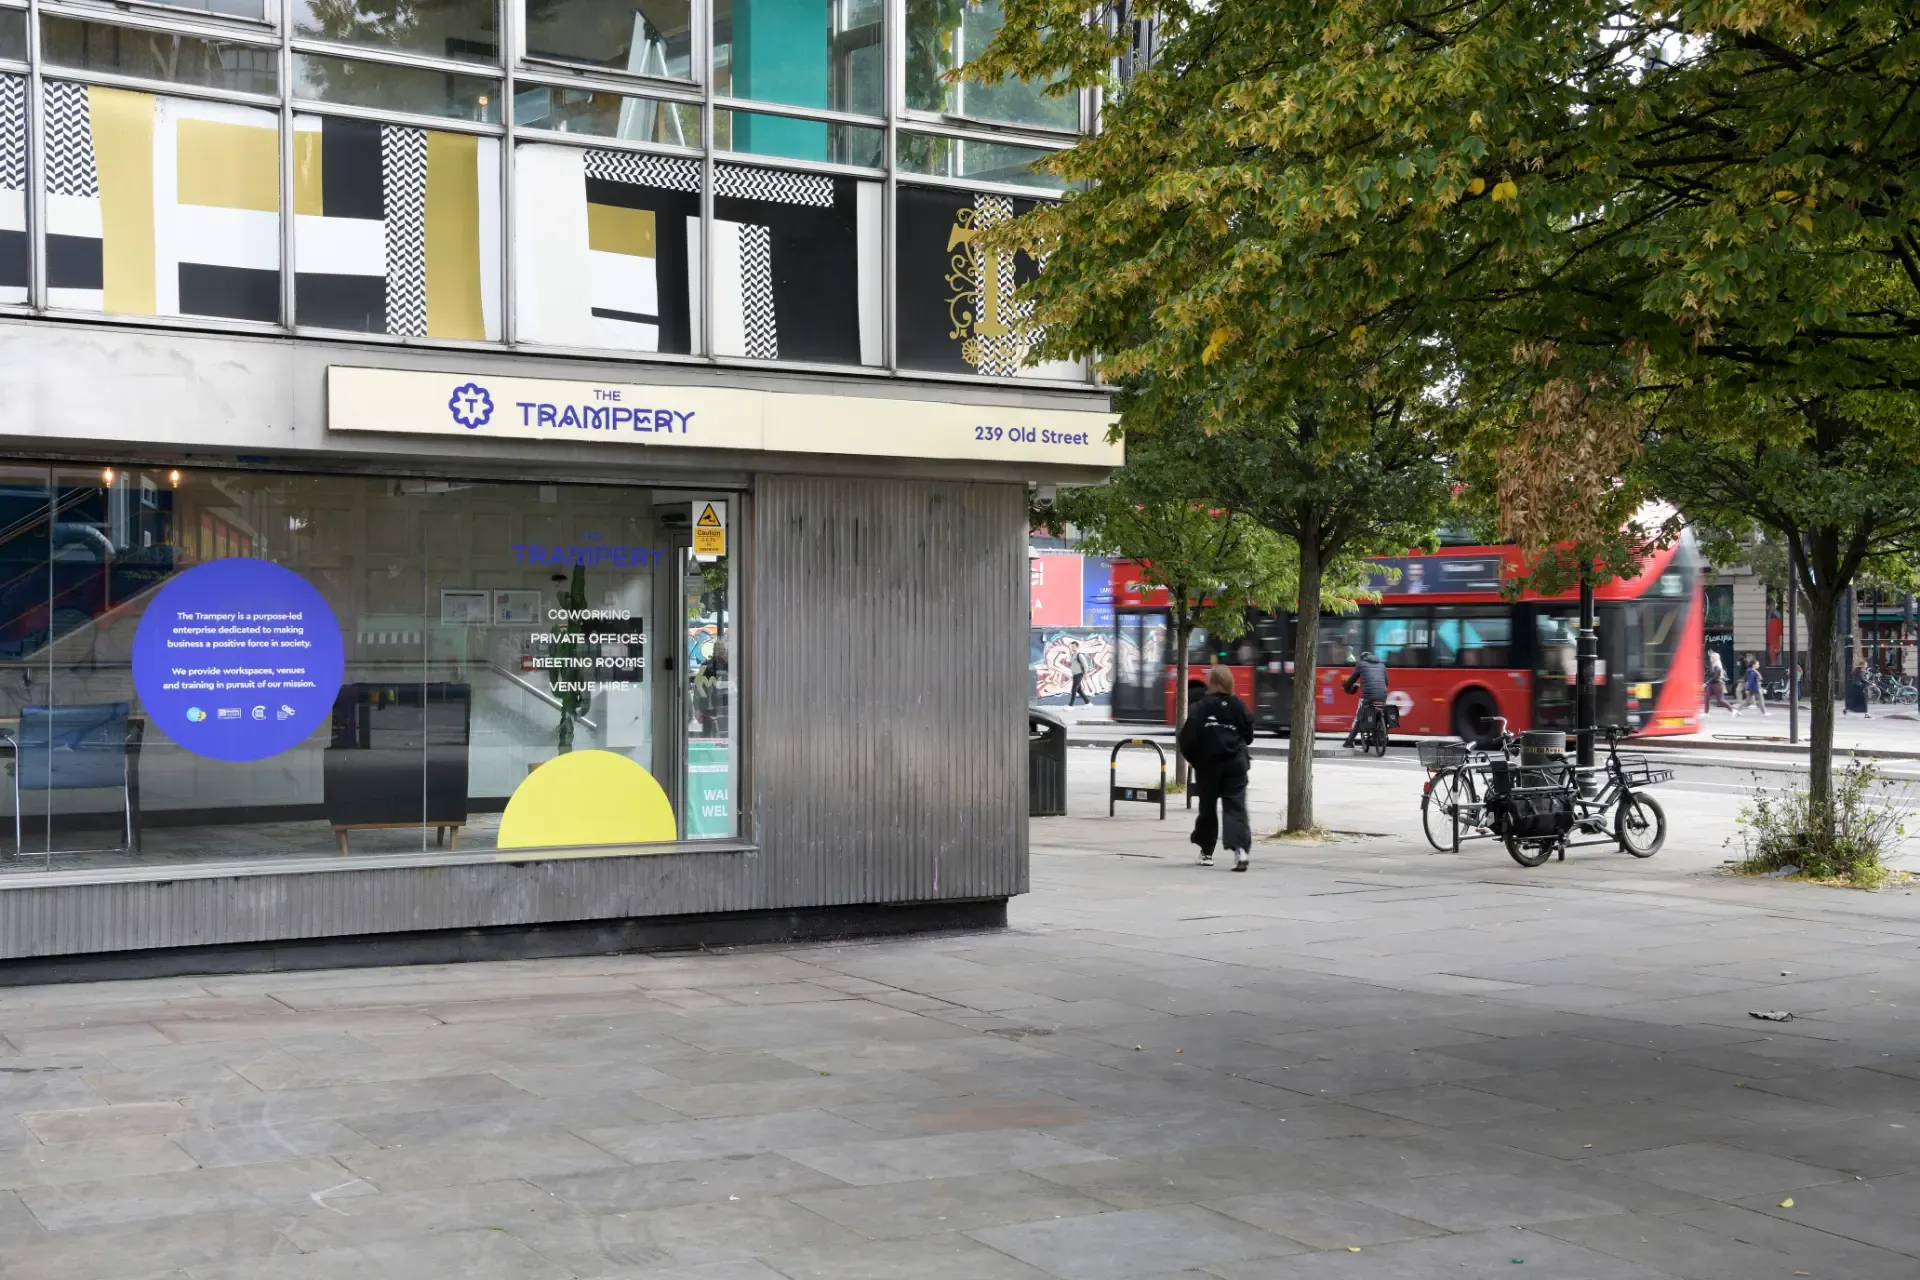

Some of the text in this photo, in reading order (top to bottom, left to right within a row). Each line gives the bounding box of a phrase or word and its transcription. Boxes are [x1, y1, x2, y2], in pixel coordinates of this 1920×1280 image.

[594, 389, 621, 401] THE
[516, 401, 695, 433] TRAMPERY
[975, 426, 1089, 446] 239 Old Street
[579, 531, 602, 542] THE
[512, 544, 667, 568] TRAMPERY
[177, 611, 194, 620] The
[195, 611, 236, 622] Trampery
[237, 612, 245, 620] is
[253, 611, 303, 621] purpose-led
[547, 609, 631, 621] COWORKING
[172, 626, 217, 635] enterprise
[218, 626, 261, 634] dedicated
[273, 626, 304, 635] making
[167, 639, 204, 648] business
[212, 639, 246, 649] positive
[247, 639, 270, 648] force
[271, 639, 279, 648] in
[280, 639, 312, 649] society.
[530, 633, 648, 645] PRIVATE OFFICES
[532, 656, 646, 669] MEETING ROOMS
[172, 667, 305, 677] We provide workspaces, venues
[163, 681, 180, 690] and
[181, 681, 215, 691] training
[216, 681, 225, 690] in
[226, 680, 255, 690] pursuit
[257, 679, 267, 689] of
[283, 679, 317, 689] mission.
[549, 681, 630, 692] VENUE HIRE
